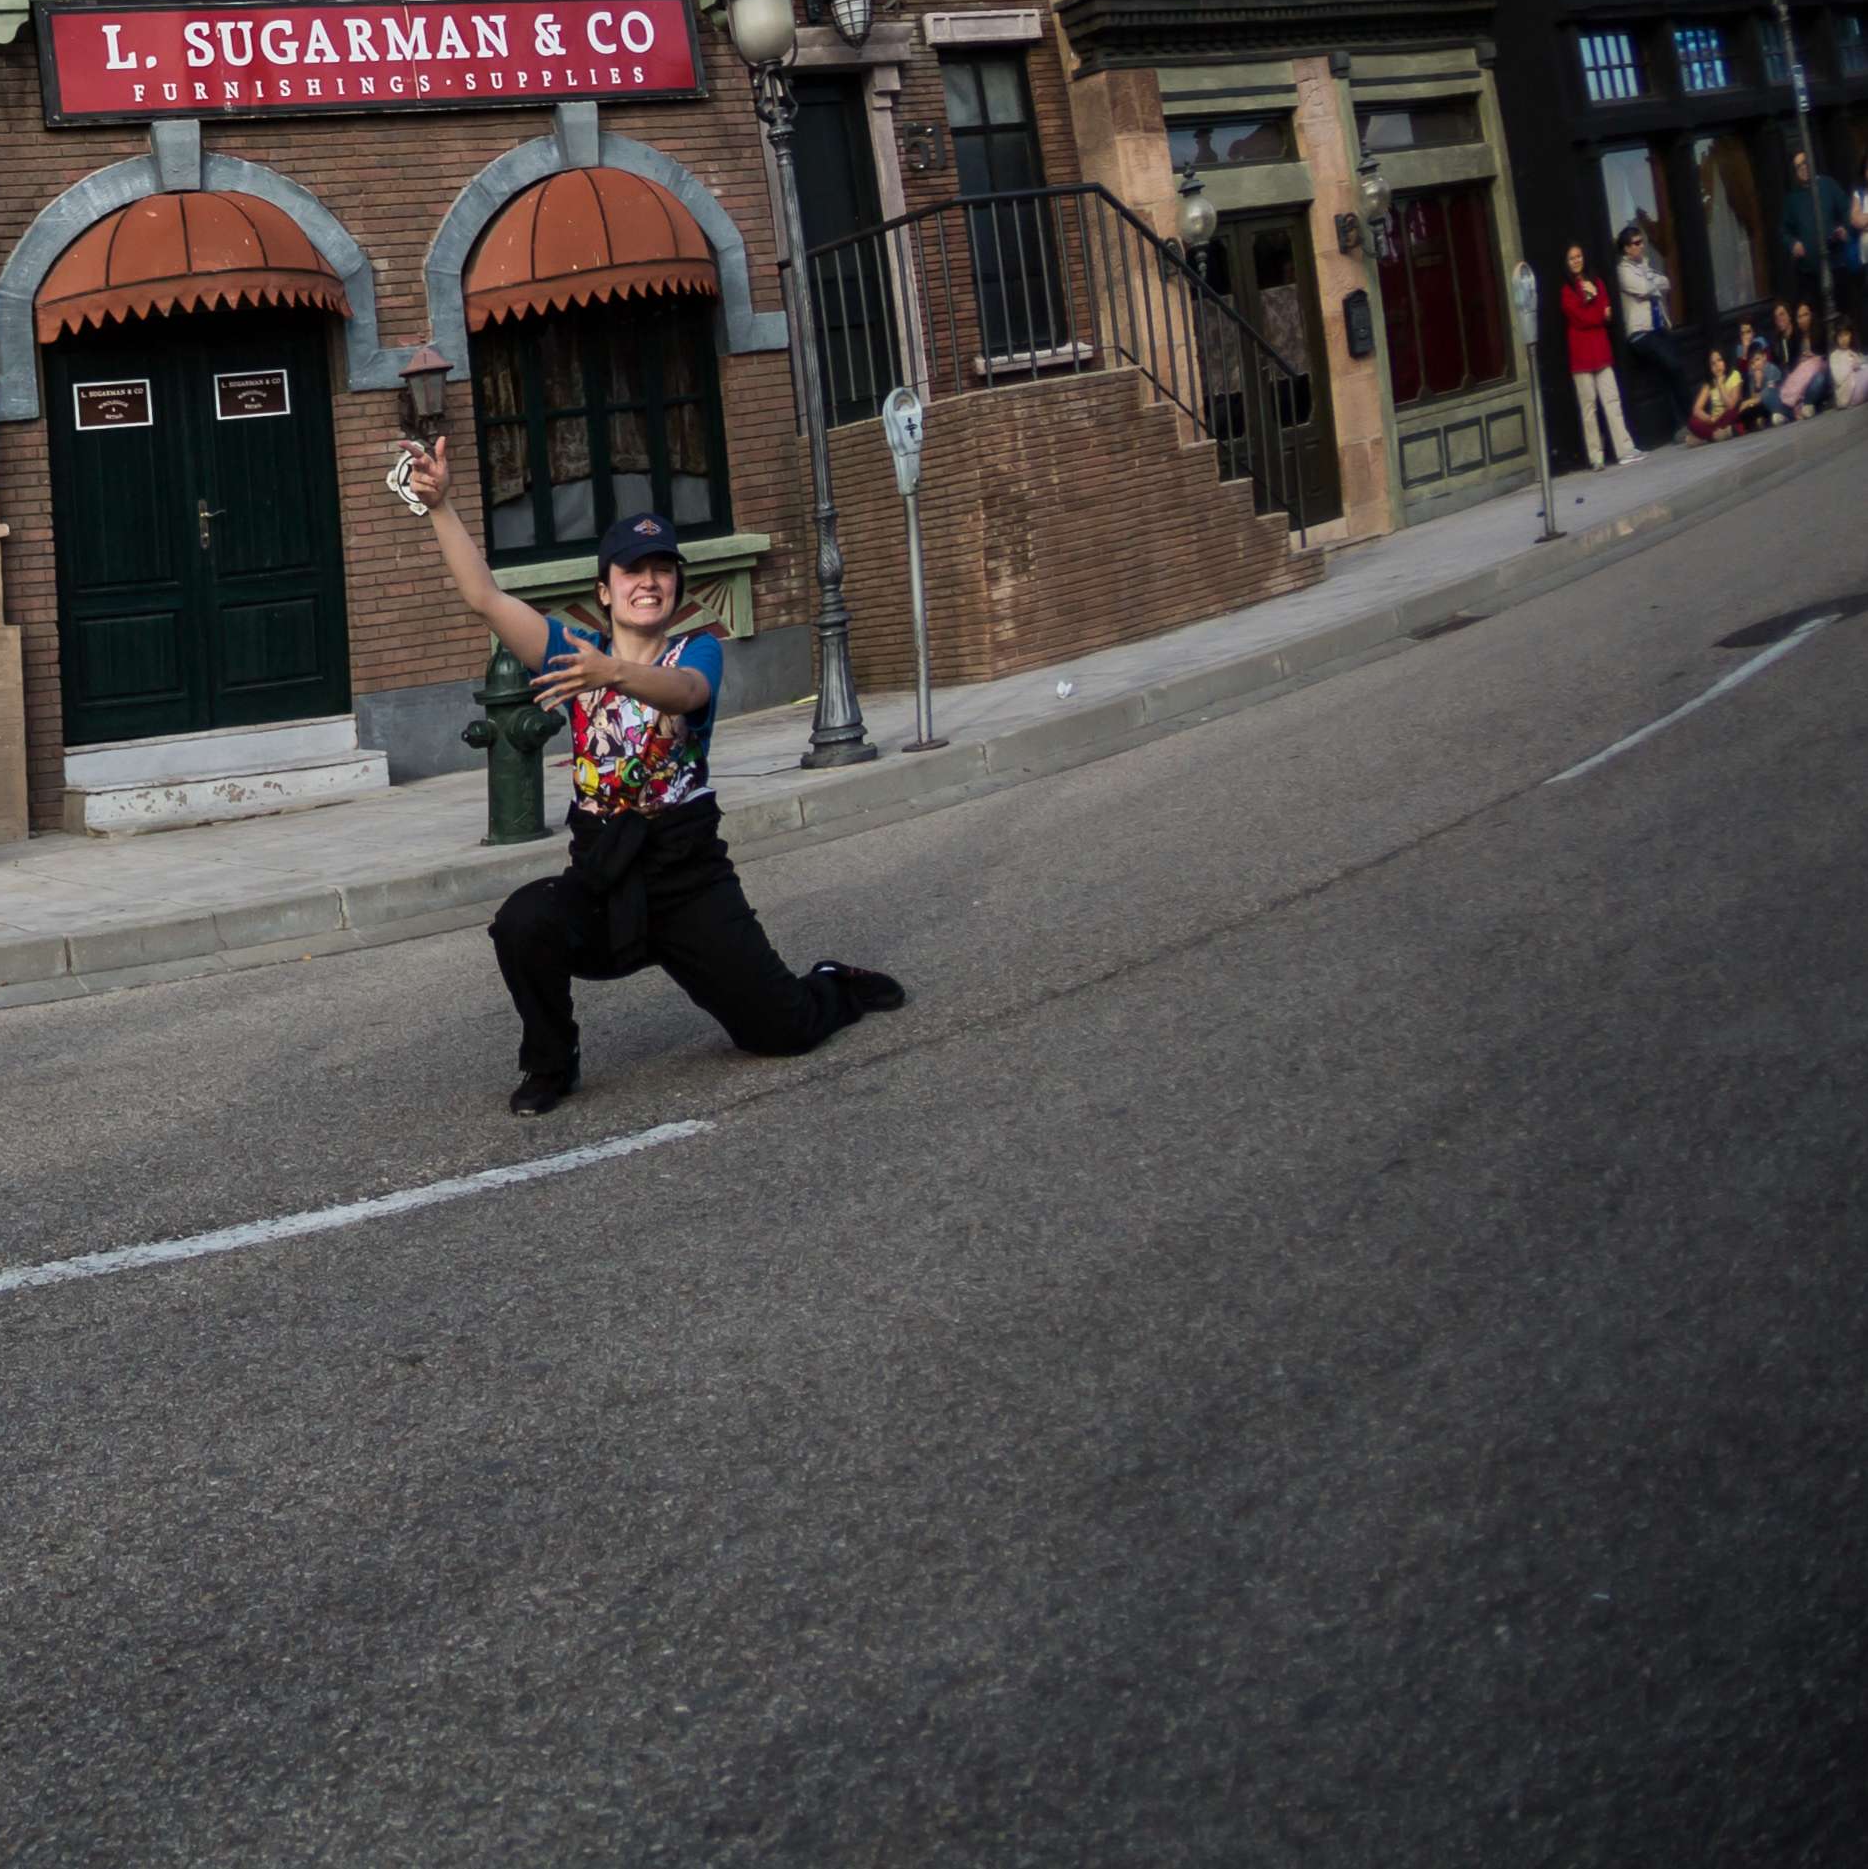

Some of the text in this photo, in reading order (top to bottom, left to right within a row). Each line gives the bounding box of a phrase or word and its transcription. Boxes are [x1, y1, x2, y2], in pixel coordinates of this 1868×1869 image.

[101, 10, 656, 70] L. SUGARMAN & CO
[133, 66, 645, 103] FURNISHINGS SUPPLIES
